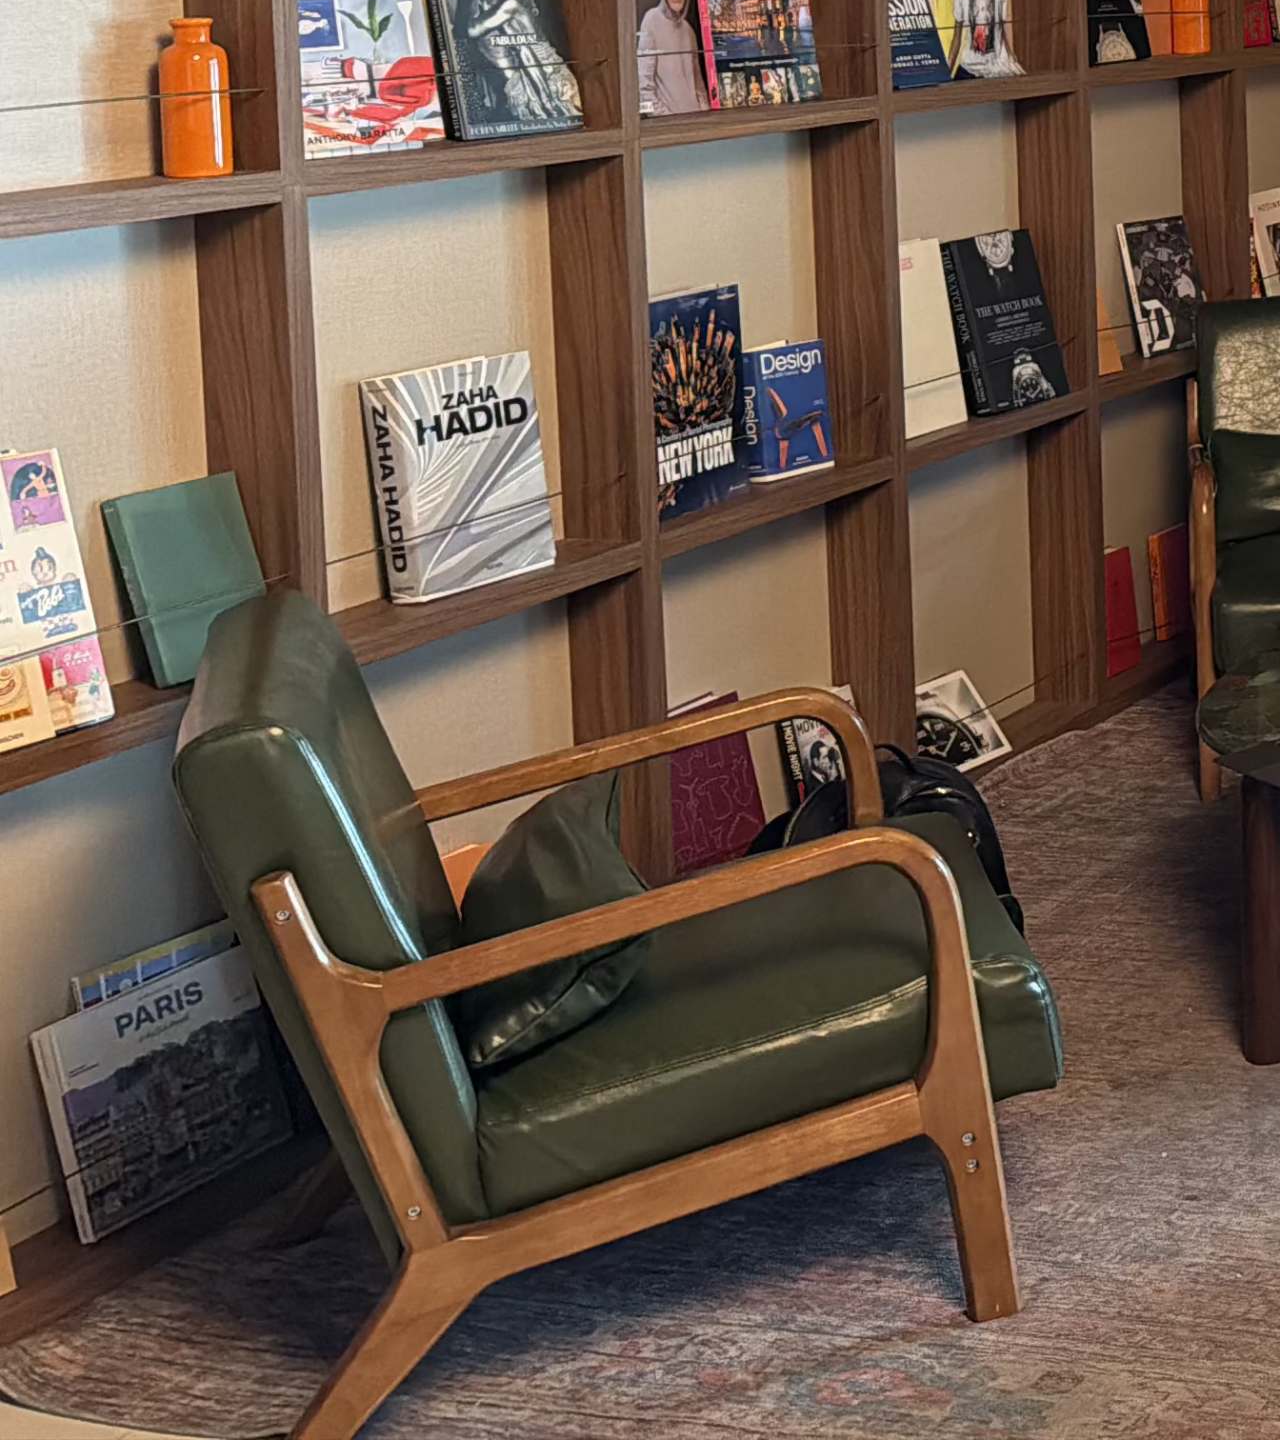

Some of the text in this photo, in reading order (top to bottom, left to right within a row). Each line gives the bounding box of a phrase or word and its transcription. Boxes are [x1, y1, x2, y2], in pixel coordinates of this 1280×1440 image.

[306, 127, 358, 146] ANTHONY
[945, 269, 964, 315] WATCH
[955, 313, 972, 344] BOOK
[974, 294, 1044, 320] THE WATCH BOOK
[760, 347, 822, 376] Design
[414, 396, 529, 447] HADID
[442, 384, 499, 412] ZAHA
[743, 386, 760, 446] Design
[371, 404, 395, 483] ZAHA
[656, 437, 694, 486] NEW
[693, 426, 736, 474] YORK
[382, 486, 408, 574] HADID
[783, 726, 804, 781] MOVIE NIGHT
[114, 980, 205, 1039] PARIS
